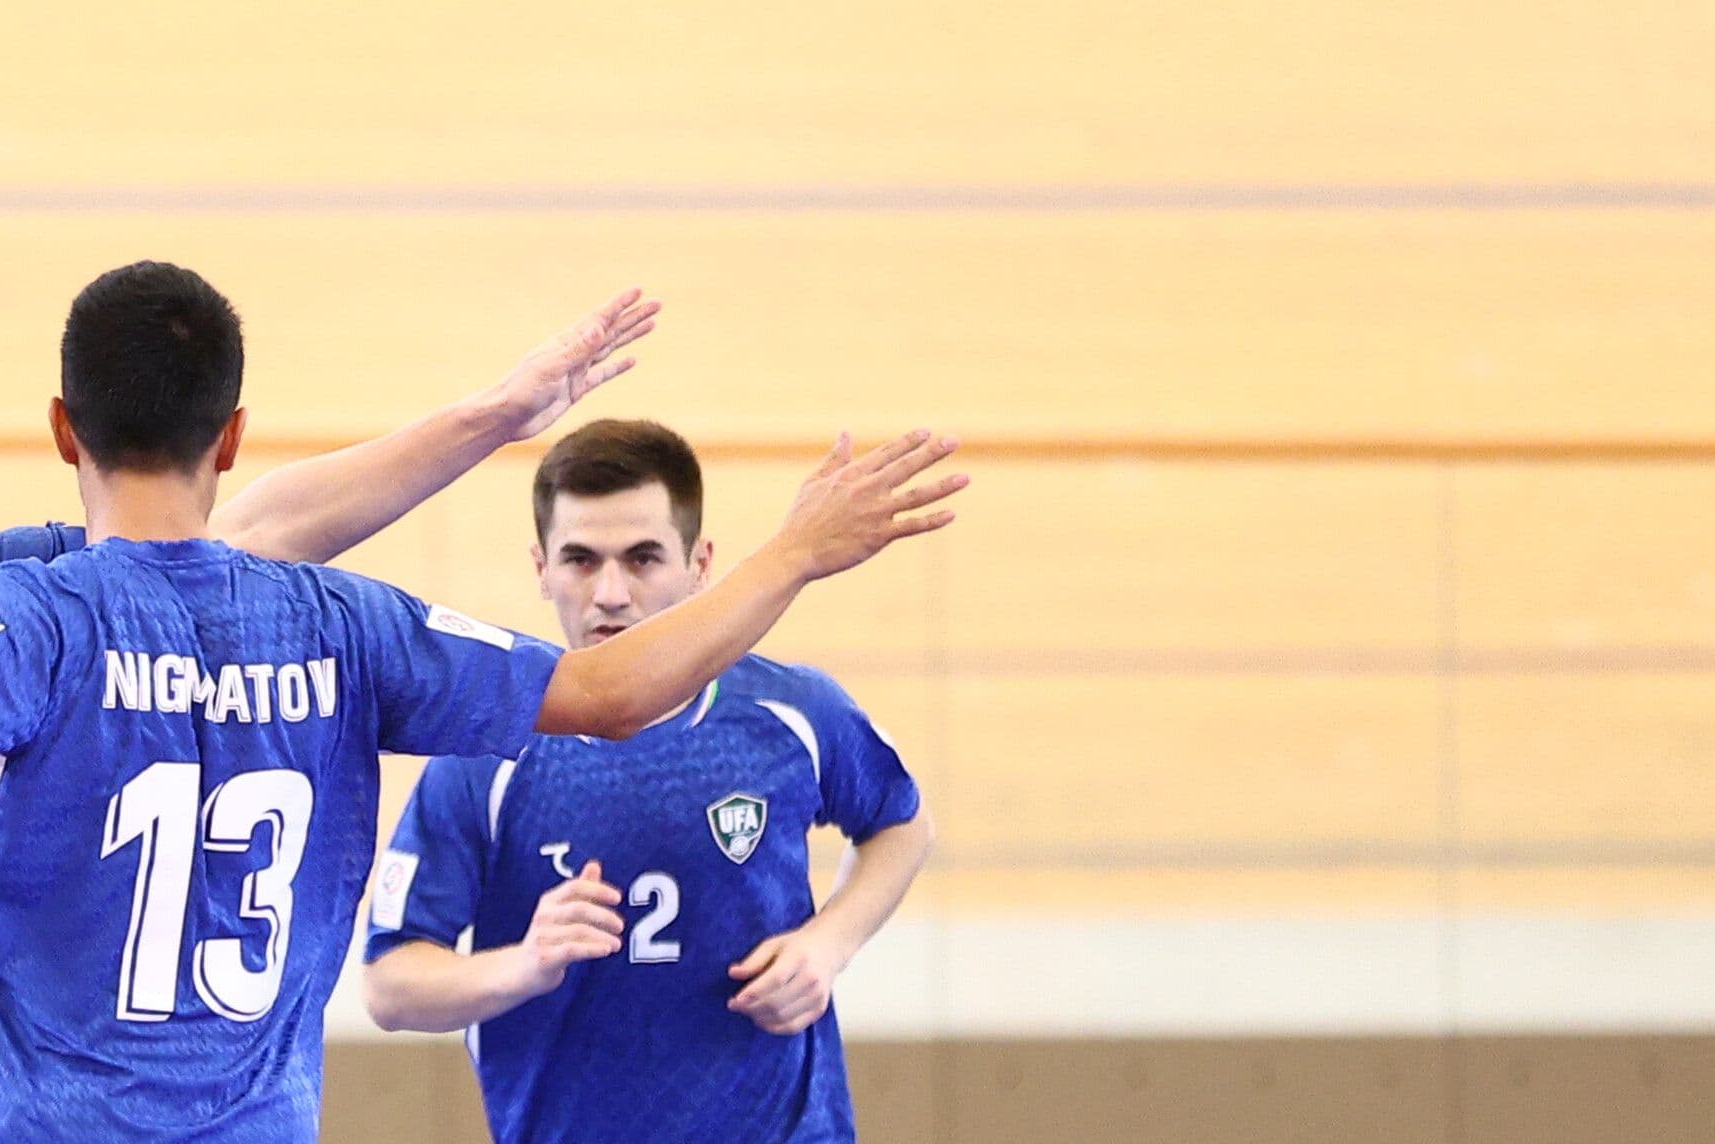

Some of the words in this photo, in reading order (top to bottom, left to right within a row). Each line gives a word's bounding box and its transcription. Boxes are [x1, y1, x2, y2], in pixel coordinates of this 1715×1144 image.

[102, 650, 336, 723] NIGMATOV
[718, 804, 759, 834] UFA
[100, 761, 314, 1022] 13
[628, 871, 682, 964] 2
